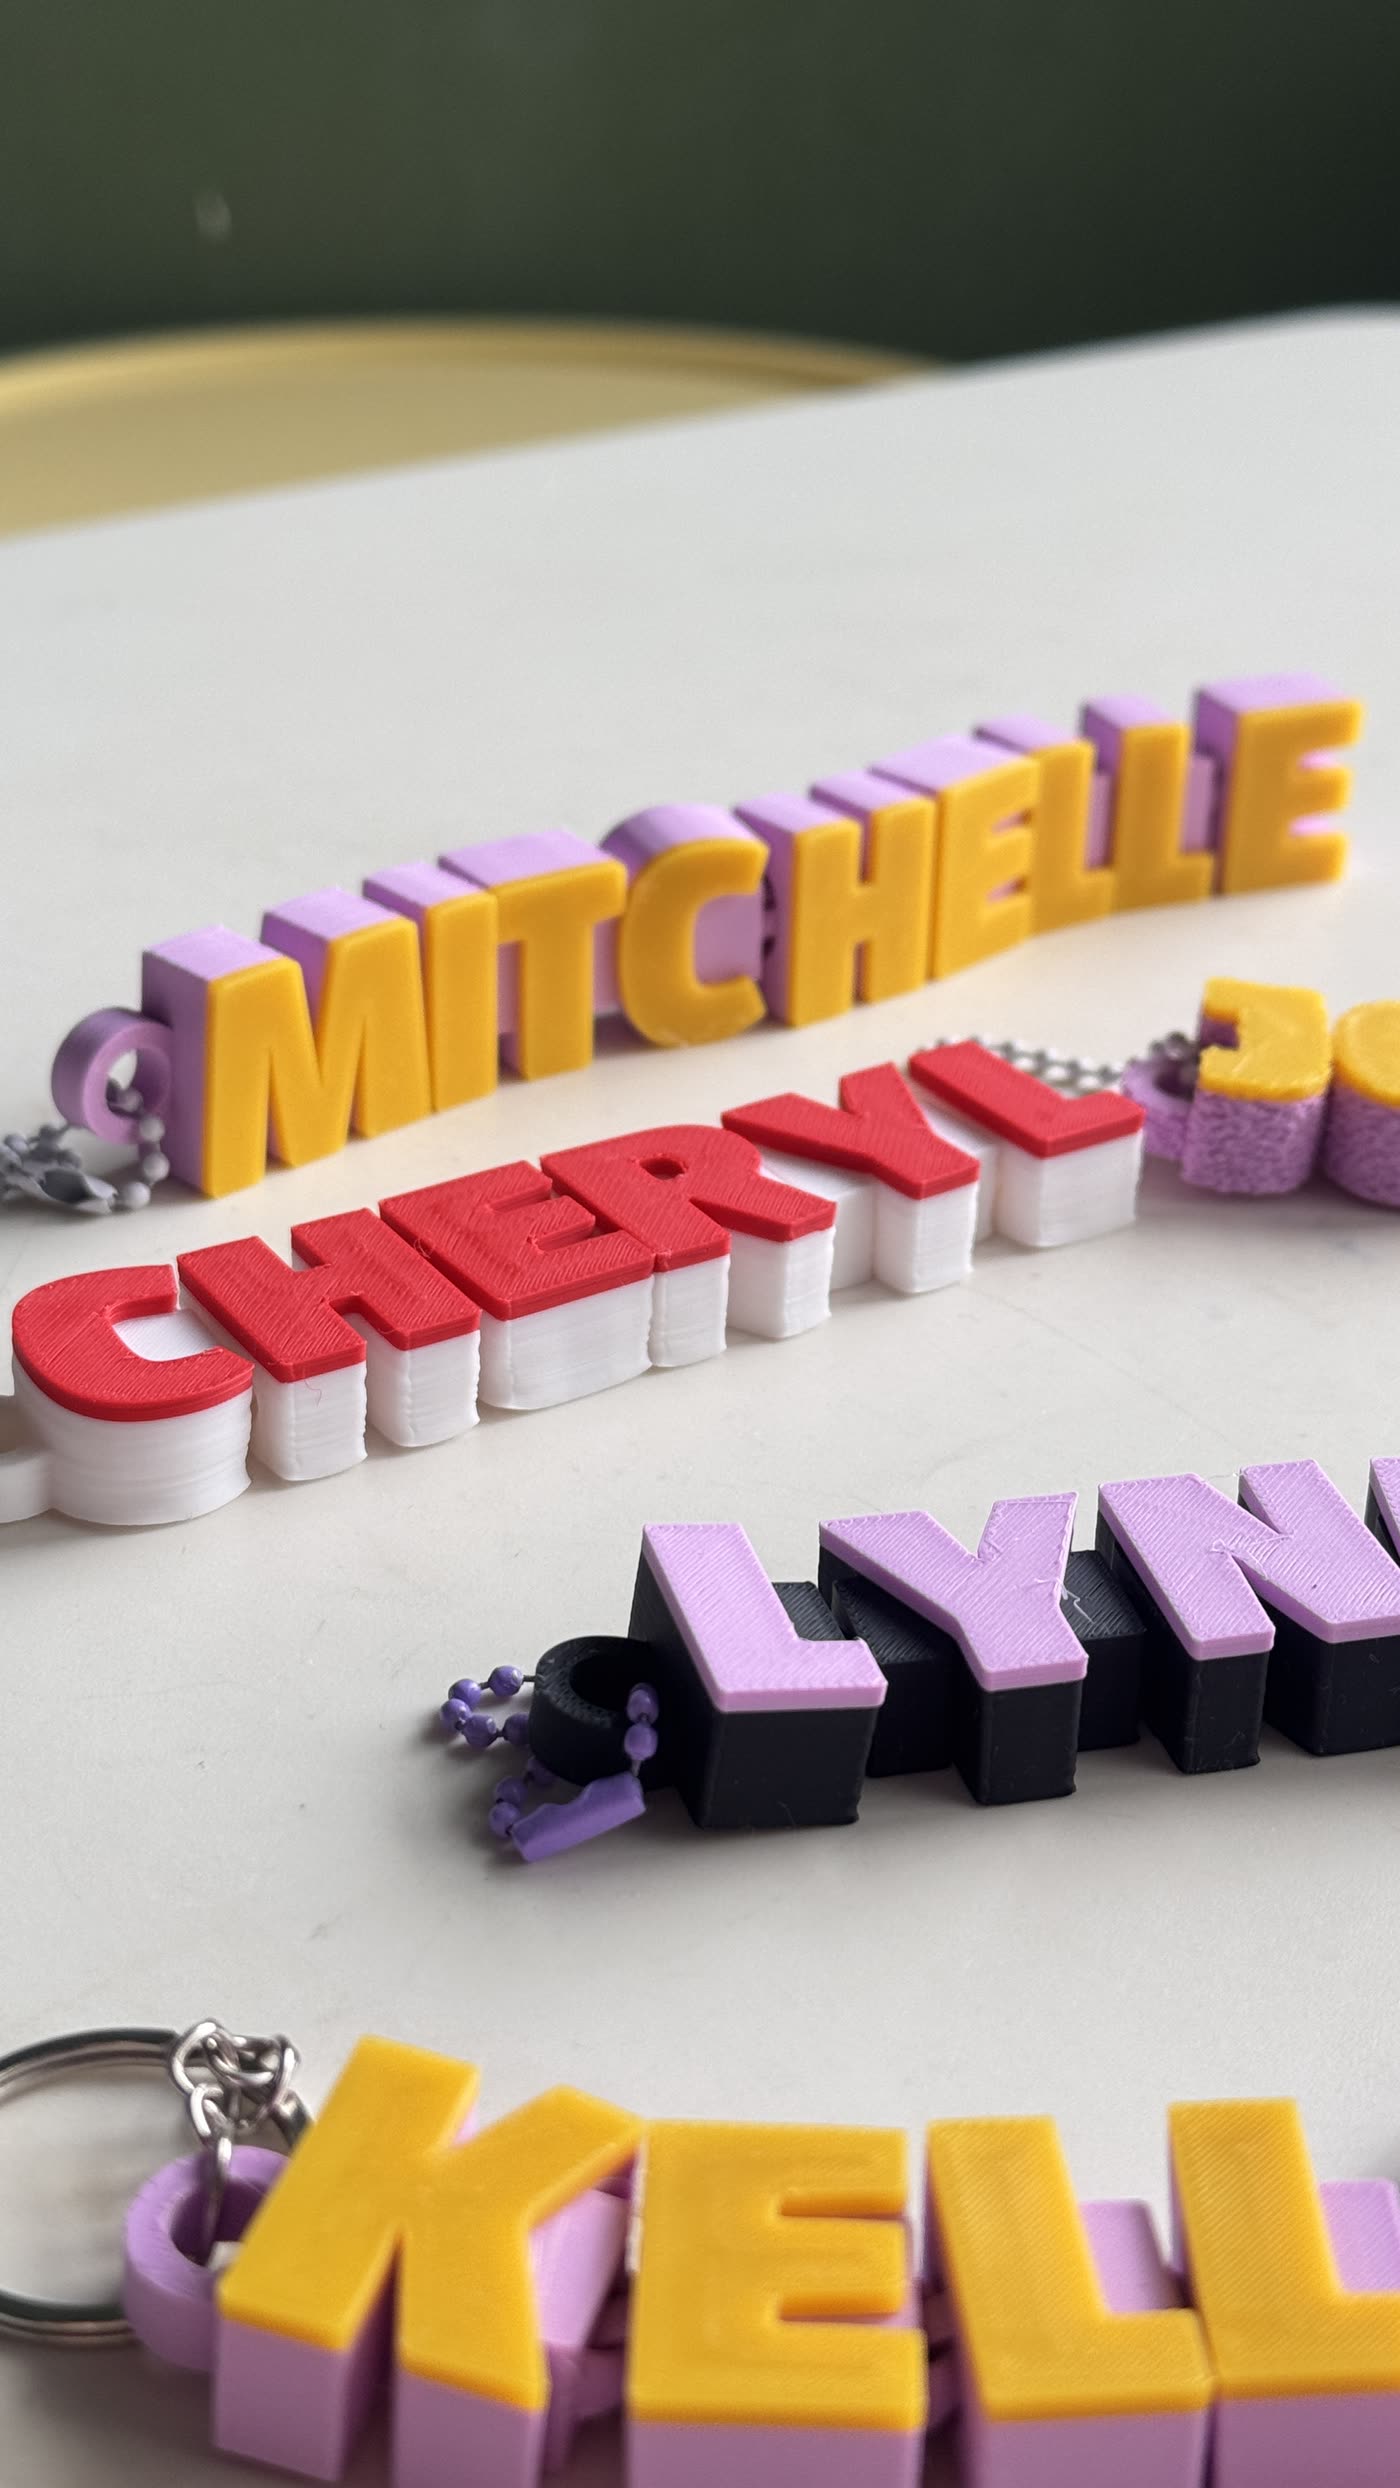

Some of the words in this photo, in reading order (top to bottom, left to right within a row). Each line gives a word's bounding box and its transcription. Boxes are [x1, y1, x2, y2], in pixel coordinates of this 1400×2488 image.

[203, 699, 1364, 1199] MITCHELLE
[12, 1040, 1146, 1423] CHERYL
[643, 1457, 1400, 1714] LYN
